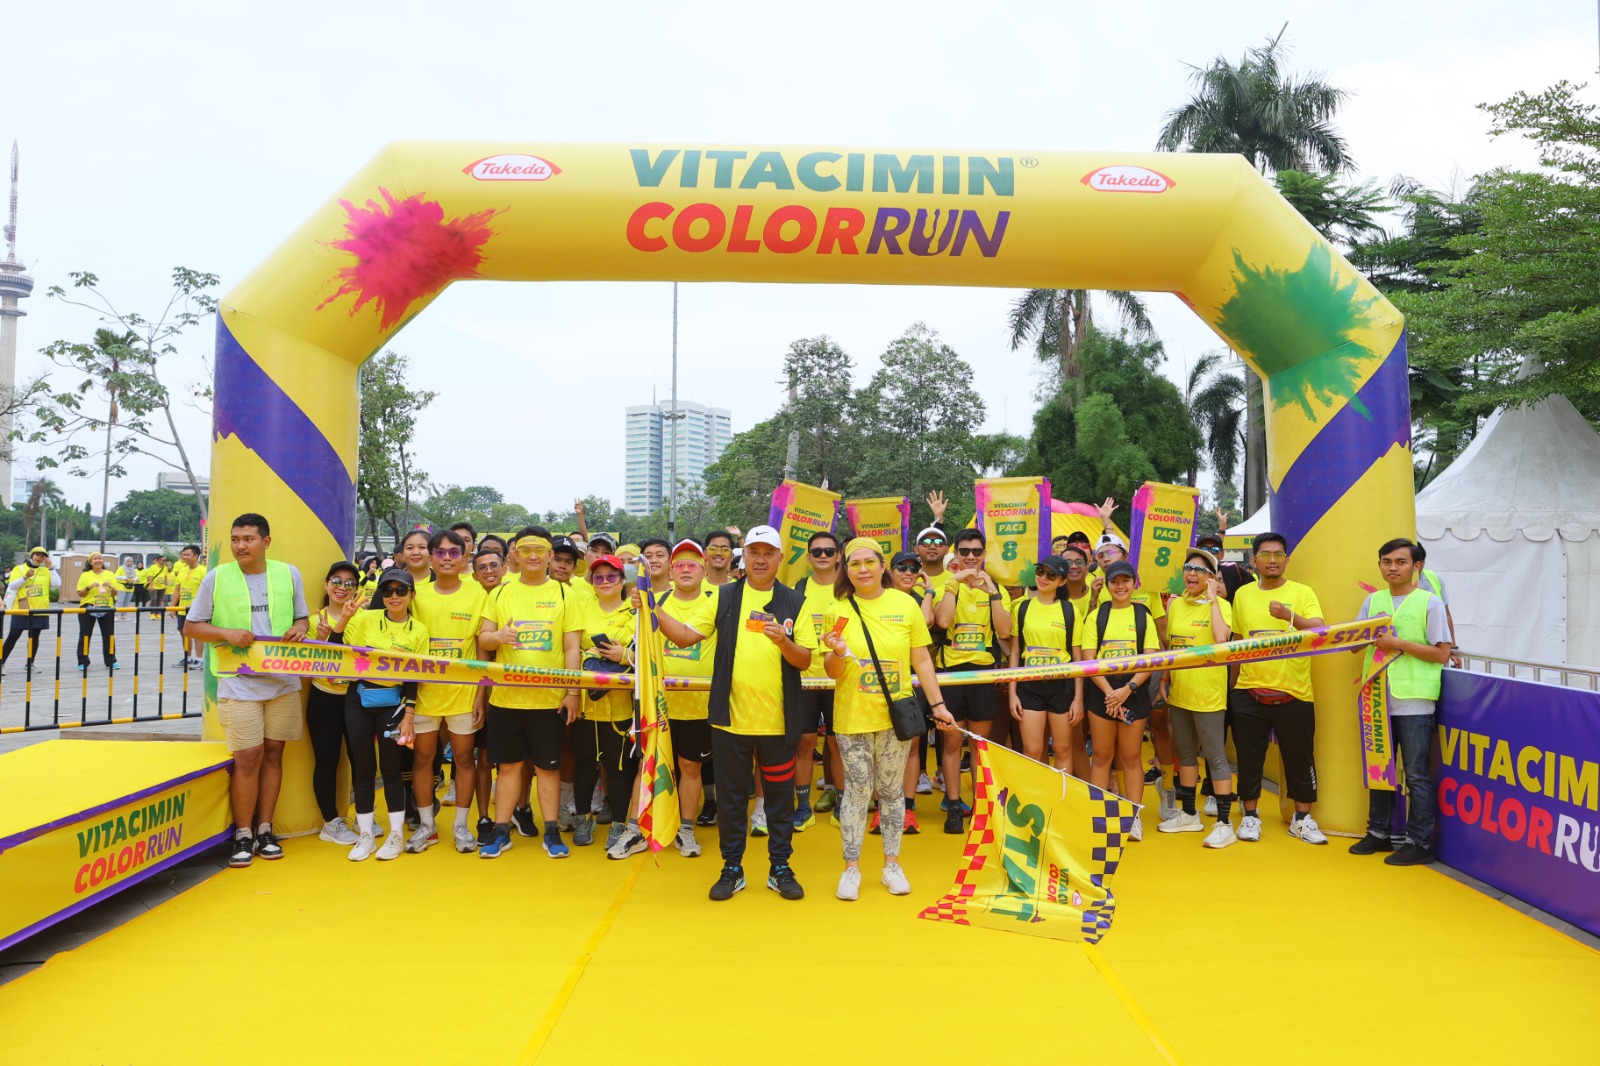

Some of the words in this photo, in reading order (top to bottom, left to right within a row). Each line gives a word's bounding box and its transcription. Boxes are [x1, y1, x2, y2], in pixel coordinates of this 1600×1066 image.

[481, 163, 546, 175] Takeda
[629, 149, 1015, 197] VITACIMIN
[1098, 174, 1162, 187] Takeda
[795, 507, 823, 519] VITACIMIN
[1154, 507, 1184, 516] VITACIMIN
[861, 522, 891, 530] VITACIMIN
[999, 523, 1025, 533] PACE
[1155, 529, 1179, 539] PACE
[787, 545, 806, 565] 7
[1001, 541, 1018, 561] 8
[1155, 546, 1171, 567] 8
[518, 631, 550, 642] 0274
[956, 633, 983, 643] 0232
[1227, 634, 1303, 653] VITACIMIN
[264, 645, 343, 661] VITACIMIN
[1104, 650, 1133, 659] 0235
[376, 656, 450, 675] START
[1029, 657, 1058, 666] 0236
[1106, 655, 1178, 672] START
[503, 664, 583, 678] VITACIMIN
[864, 672, 899, 685] 056
[1362, 680, 1374, 752] OLORRUN
[1372, 676, 1385, 754] VITACIMIN
[1438, 724, 1599, 812] VITACIM
[77, 792, 186, 859] VITACIMIN
[989, 793, 1046, 922] STAT
